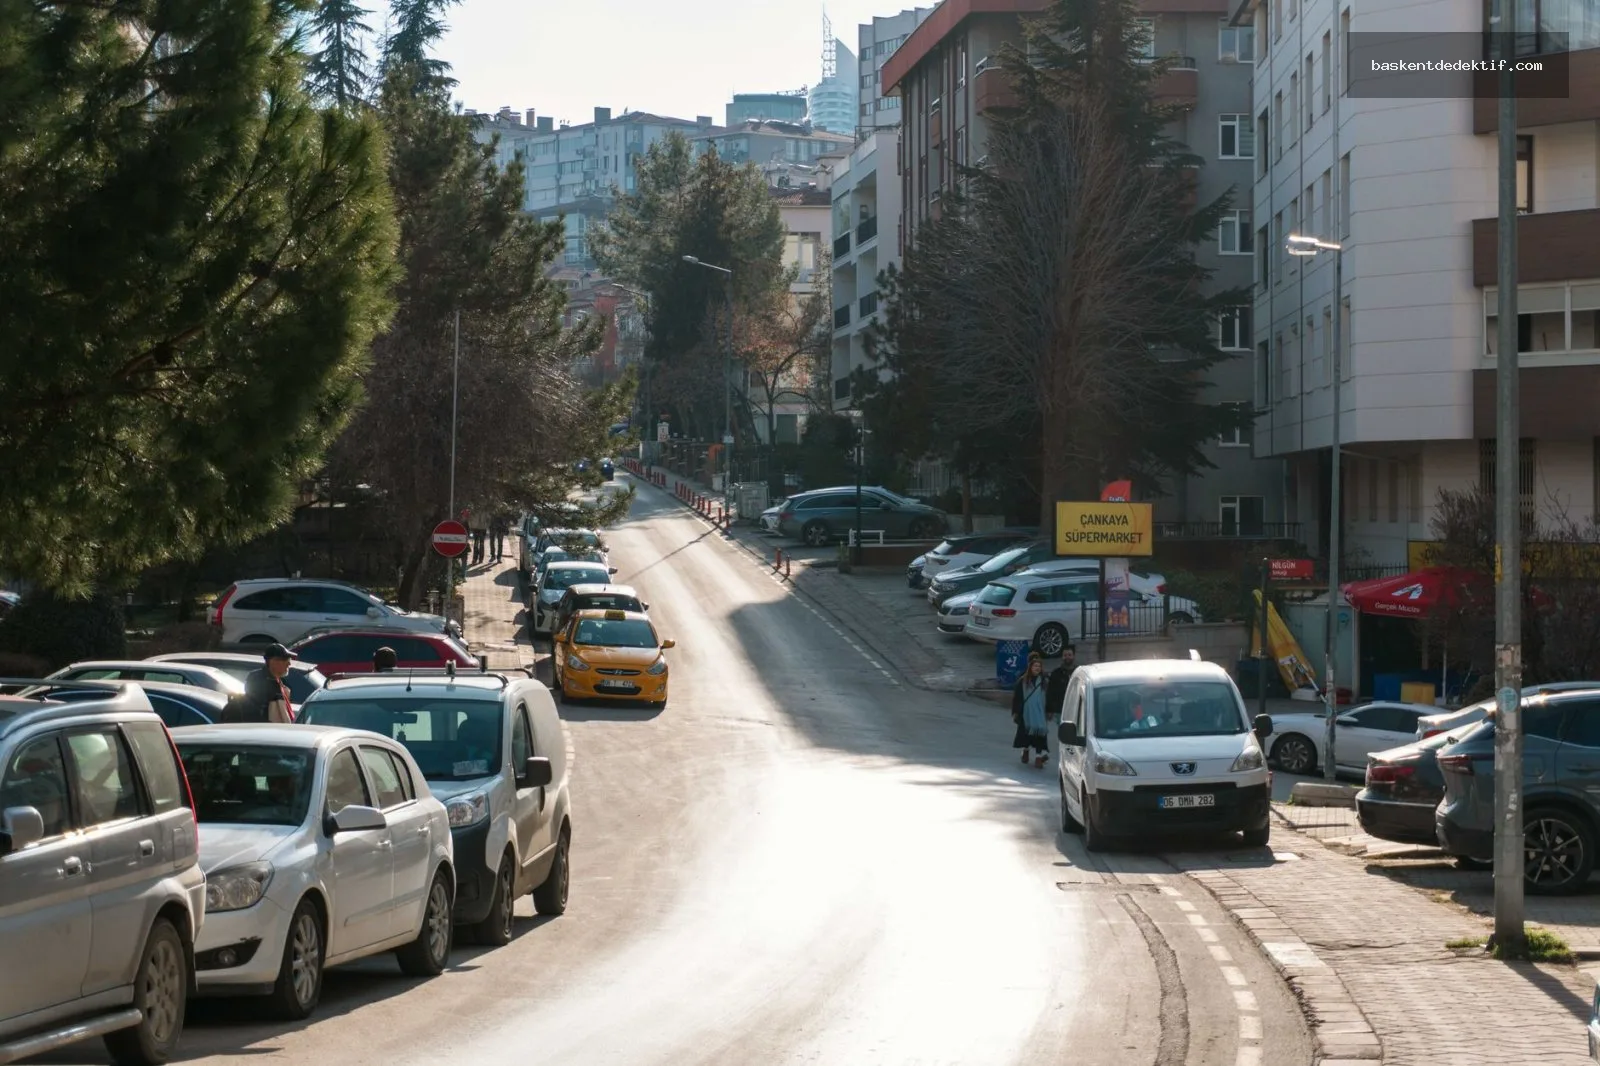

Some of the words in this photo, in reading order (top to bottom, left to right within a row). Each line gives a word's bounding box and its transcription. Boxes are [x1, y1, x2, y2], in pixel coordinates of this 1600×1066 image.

[1080, 513, 1129, 529] ÇANKAYA
[1065, 528, 1143, 544] SÜPERMARKET
[1163, 797, 1174, 807] 06
